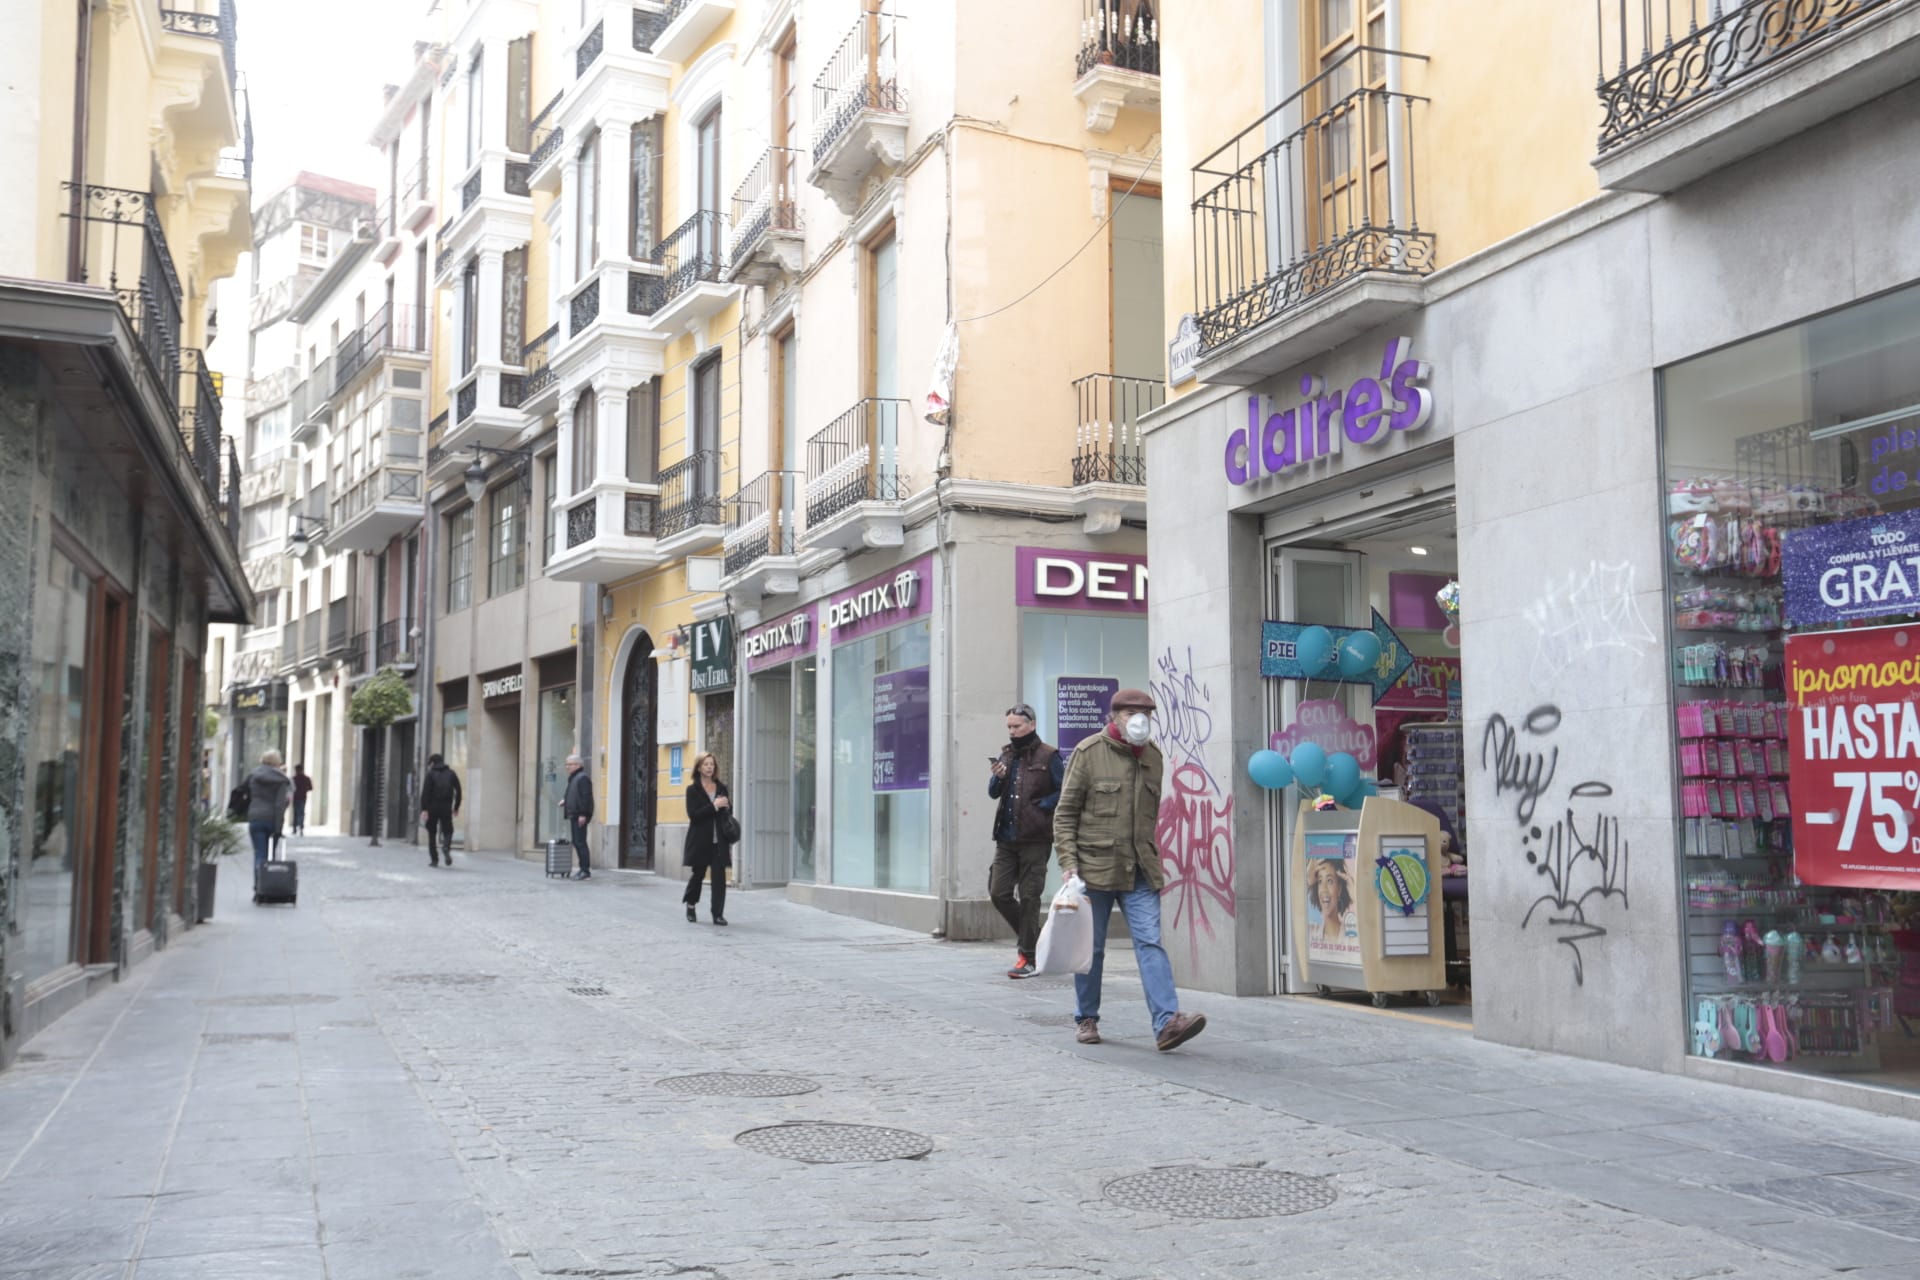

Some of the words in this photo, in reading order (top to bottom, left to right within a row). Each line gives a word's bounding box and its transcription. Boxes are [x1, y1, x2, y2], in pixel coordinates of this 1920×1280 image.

[1225, 336, 1433, 486] claire's
[1871, 425, 1920, 464] pie
[1829, 552, 1867, 565] COMPRA
[1871, 531, 1906, 547] TODO
[1035, 557, 1148, 600] DE
[828, 583, 890, 629] DENTIX
[695, 619, 725, 663] EV
[745, 621, 789, 659] DENTIX
[1301, 704, 1341, 727] ear
[1829, 694, 1845, 704] the
[1849, 691, 1867, 703] fun
[1803, 702, 1920, 760] HASTA
[1391, 866, 1412, 906] SEMANAS
